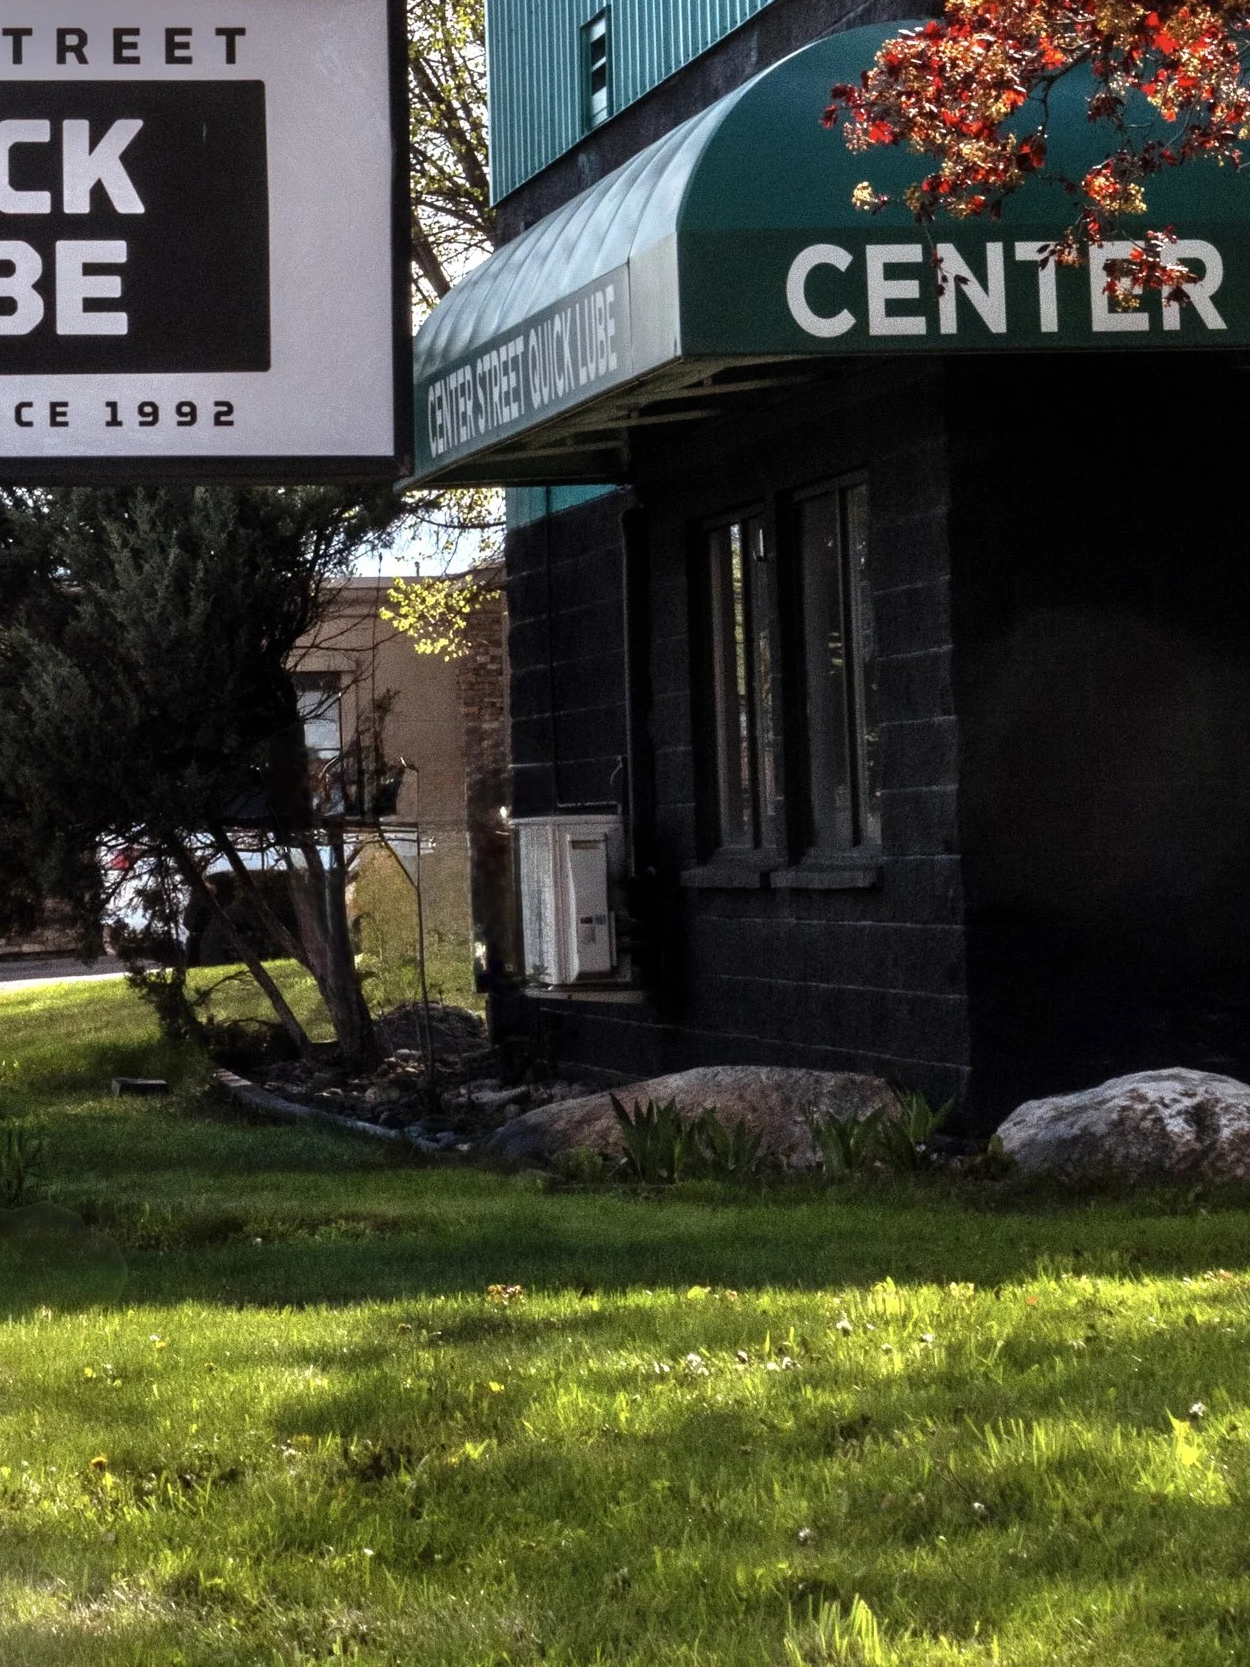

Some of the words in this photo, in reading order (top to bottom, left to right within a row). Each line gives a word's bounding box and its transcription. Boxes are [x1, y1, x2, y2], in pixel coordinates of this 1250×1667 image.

[787, 238, 1228, 338] CENTER
[105, 400, 236, 428] 1992
[427, 365, 475, 458] CENTER
[476, 336, 526, 434] STREET
[528, 308, 575, 409] QUICK
[576, 284, 617, 387] LUBE
